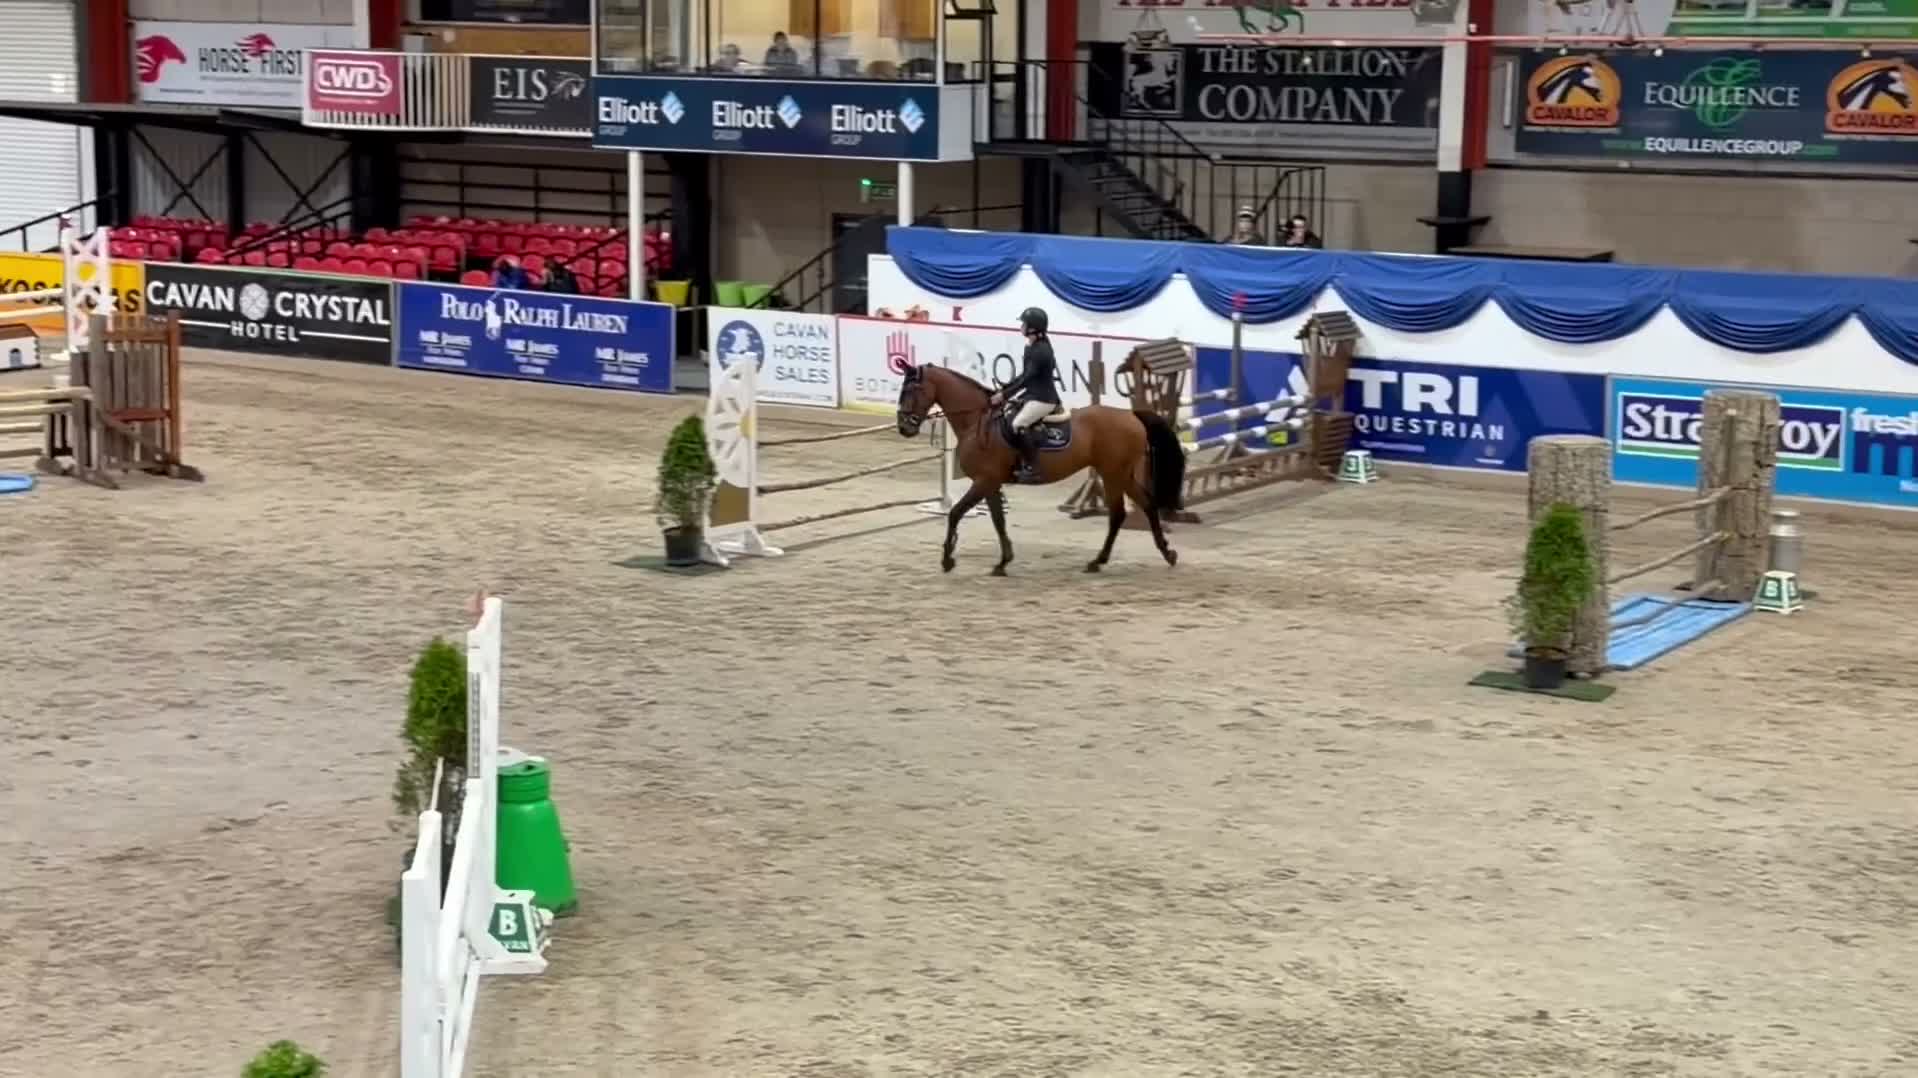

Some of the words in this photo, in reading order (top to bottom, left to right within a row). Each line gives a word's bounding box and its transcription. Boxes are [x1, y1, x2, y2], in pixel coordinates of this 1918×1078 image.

[198, 47, 249, 73] HORSE
[261, 49, 303, 74] FIRST
[1199, 47, 1257, 74] THE
[1264, 48, 1408, 77] STALLION
[317, 65, 377, 90] CWD
[493, 67, 549, 101] EIS
[1199, 84, 1403, 124] COMPANY
[1644, 81, 1800, 107] EQUILLENCE
[599, 97, 659, 125] Elliott
[712, 101, 775, 130] Elliott
[831, 104, 897, 134] Elliott
[1532, 104, 1609, 123] CAVALOR
[1832, 112, 1918, 129] CAVALOR
[147, 280, 235, 312] CAVAN
[274, 291, 391, 325] CRYSTAL
[230, 320, 300, 342] HOTEL
[773, 321, 829, 339] CAVAN
[774, 344, 831, 363] HORSE
[775, 365, 830, 385] SALES
[1347, 368, 1479, 417] TRI
[1354, 413, 1504, 441] QUESTRIAN
[499, 908, 519, 935] B
